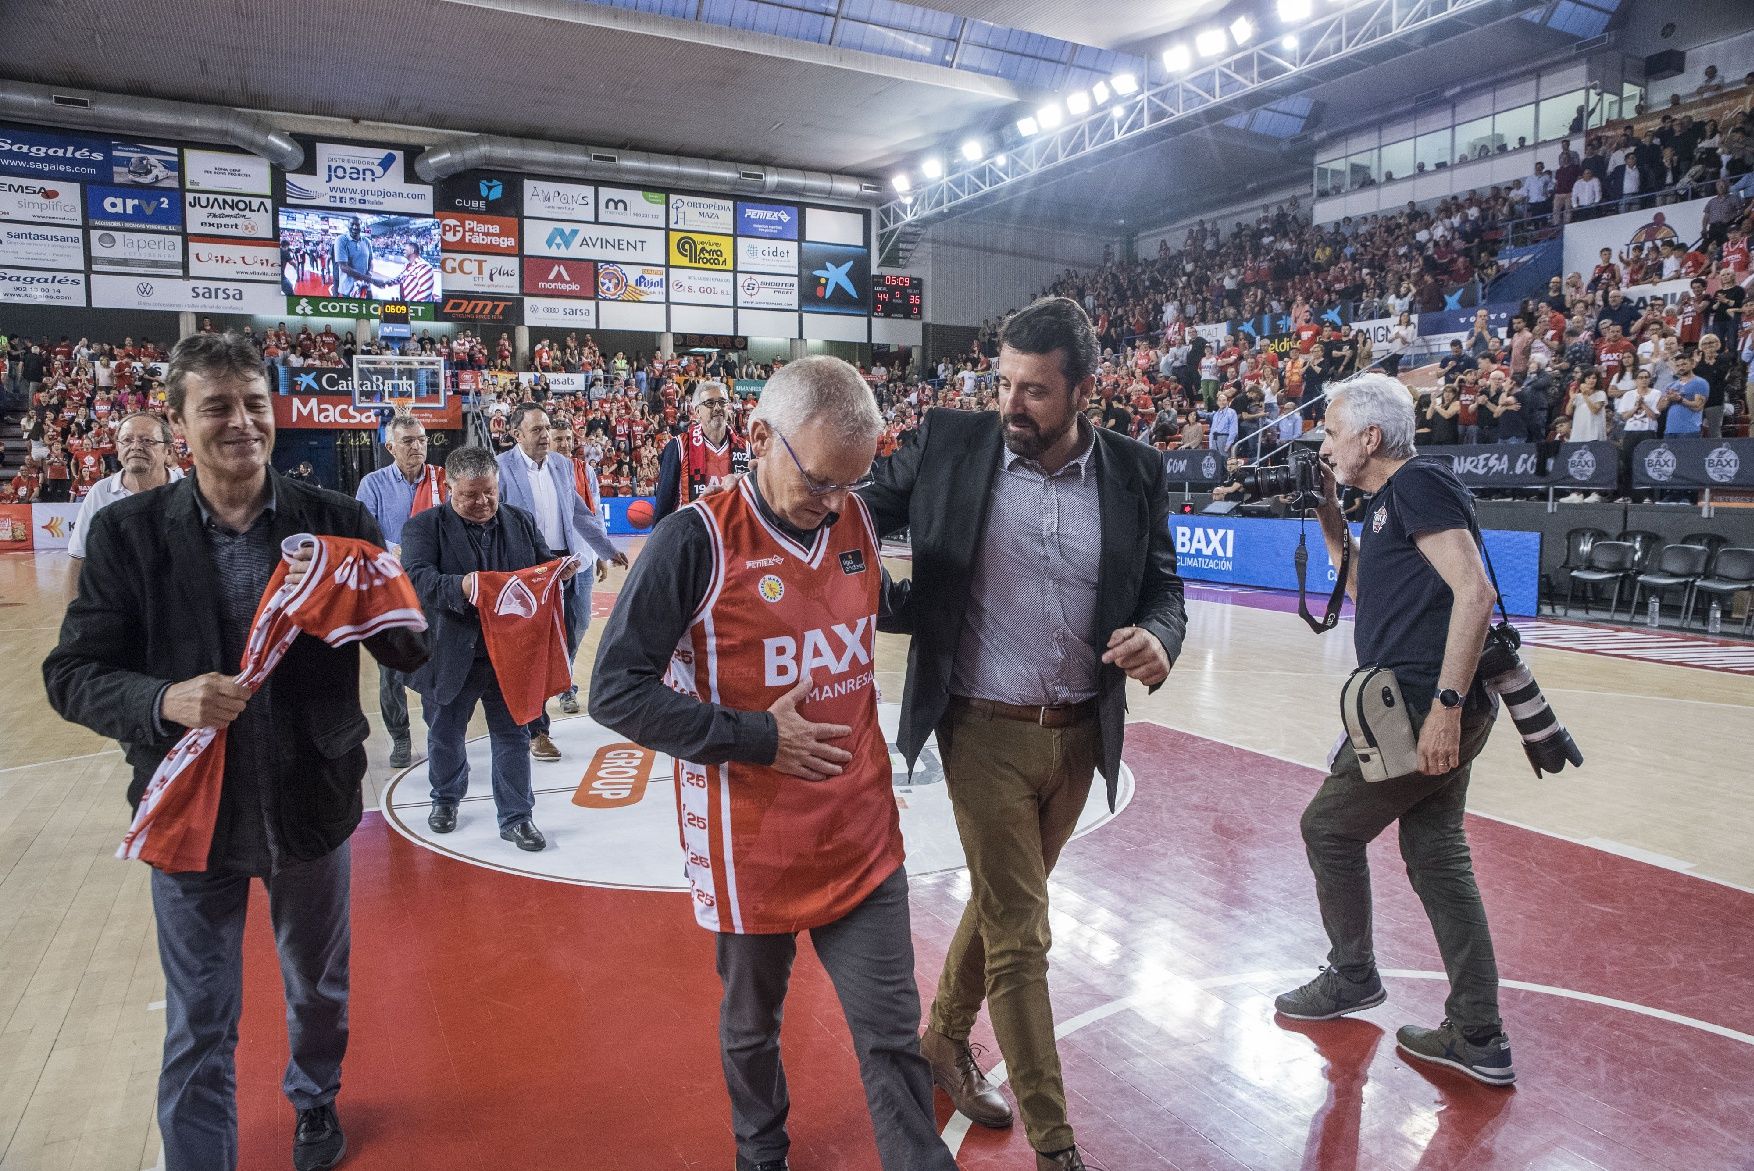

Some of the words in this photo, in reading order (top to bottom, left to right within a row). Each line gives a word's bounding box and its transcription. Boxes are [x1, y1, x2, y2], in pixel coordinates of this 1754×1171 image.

[328, 186, 426, 200] www.grupjoan.com
[18, 200, 77, 213] simplifica
[188, 196, 269, 214] JUANOLA
[455, 199, 486, 209] CUBE
[200, 221, 240, 231] expert
[464, 221, 500, 234] Plana
[6, 231, 80, 244] santasusana
[579, 236, 647, 252] AVINENT
[441, 257, 488, 278] GCT
[885, 275, 910, 286] 05:09
[191, 286, 243, 301] sarsa
[909, 295, 920, 305] 36
[318, 301, 359, 314] COTS
[443, 299, 513, 315] DMT
[562, 307, 590, 317] sarsa
[322, 373, 412, 392] CaixaBank
[292, 397, 377, 424] Macsa
[1452, 453, 1555, 476] NRESA.CO
[1647, 459, 1676, 468] BAXI
[1707, 459, 1739, 468] BAXI
[1176, 526, 1235, 558] BAXI
[762, 613, 877, 688] BAXI
[804, 670, 876, 706] MANRESA
[588, 748, 645, 800] GROUP
[686, 771, 707, 790] 25
[687, 811, 708, 831] 25
[690, 850, 711, 869] 25
[695, 888, 717, 908] 25
